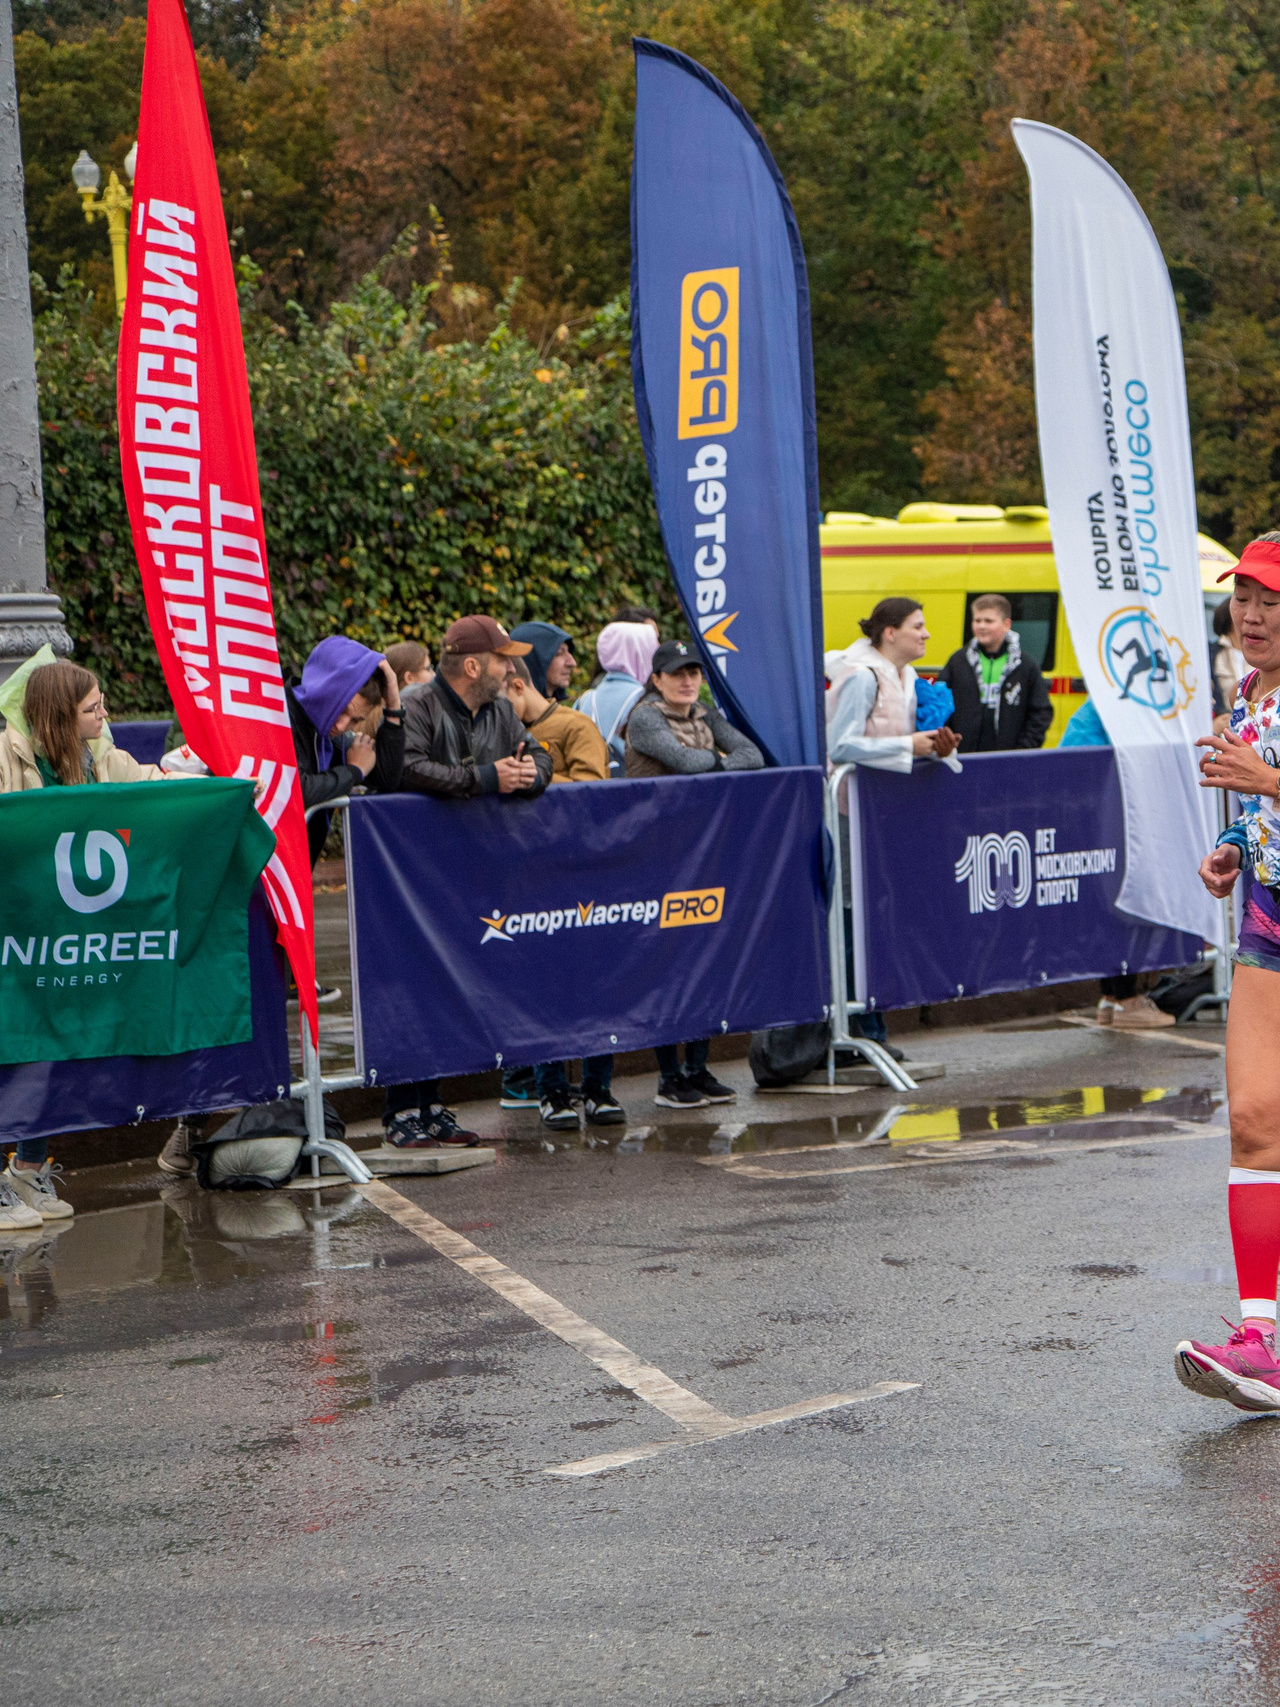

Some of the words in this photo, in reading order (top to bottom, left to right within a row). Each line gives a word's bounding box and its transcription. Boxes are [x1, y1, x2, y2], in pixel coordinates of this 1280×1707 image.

[1035, 828, 1056, 854] ЛЕТ
[954, 831, 1032, 914] 100
[1035, 848, 1117, 880] МОСКОВСКОМУ
[1036, 878, 1079, 906] СПОРТУ
[664, 894, 719, 922] PRO
[1, 929, 178, 965] NIGREE
[36, 972, 122, 987] ENERGY
